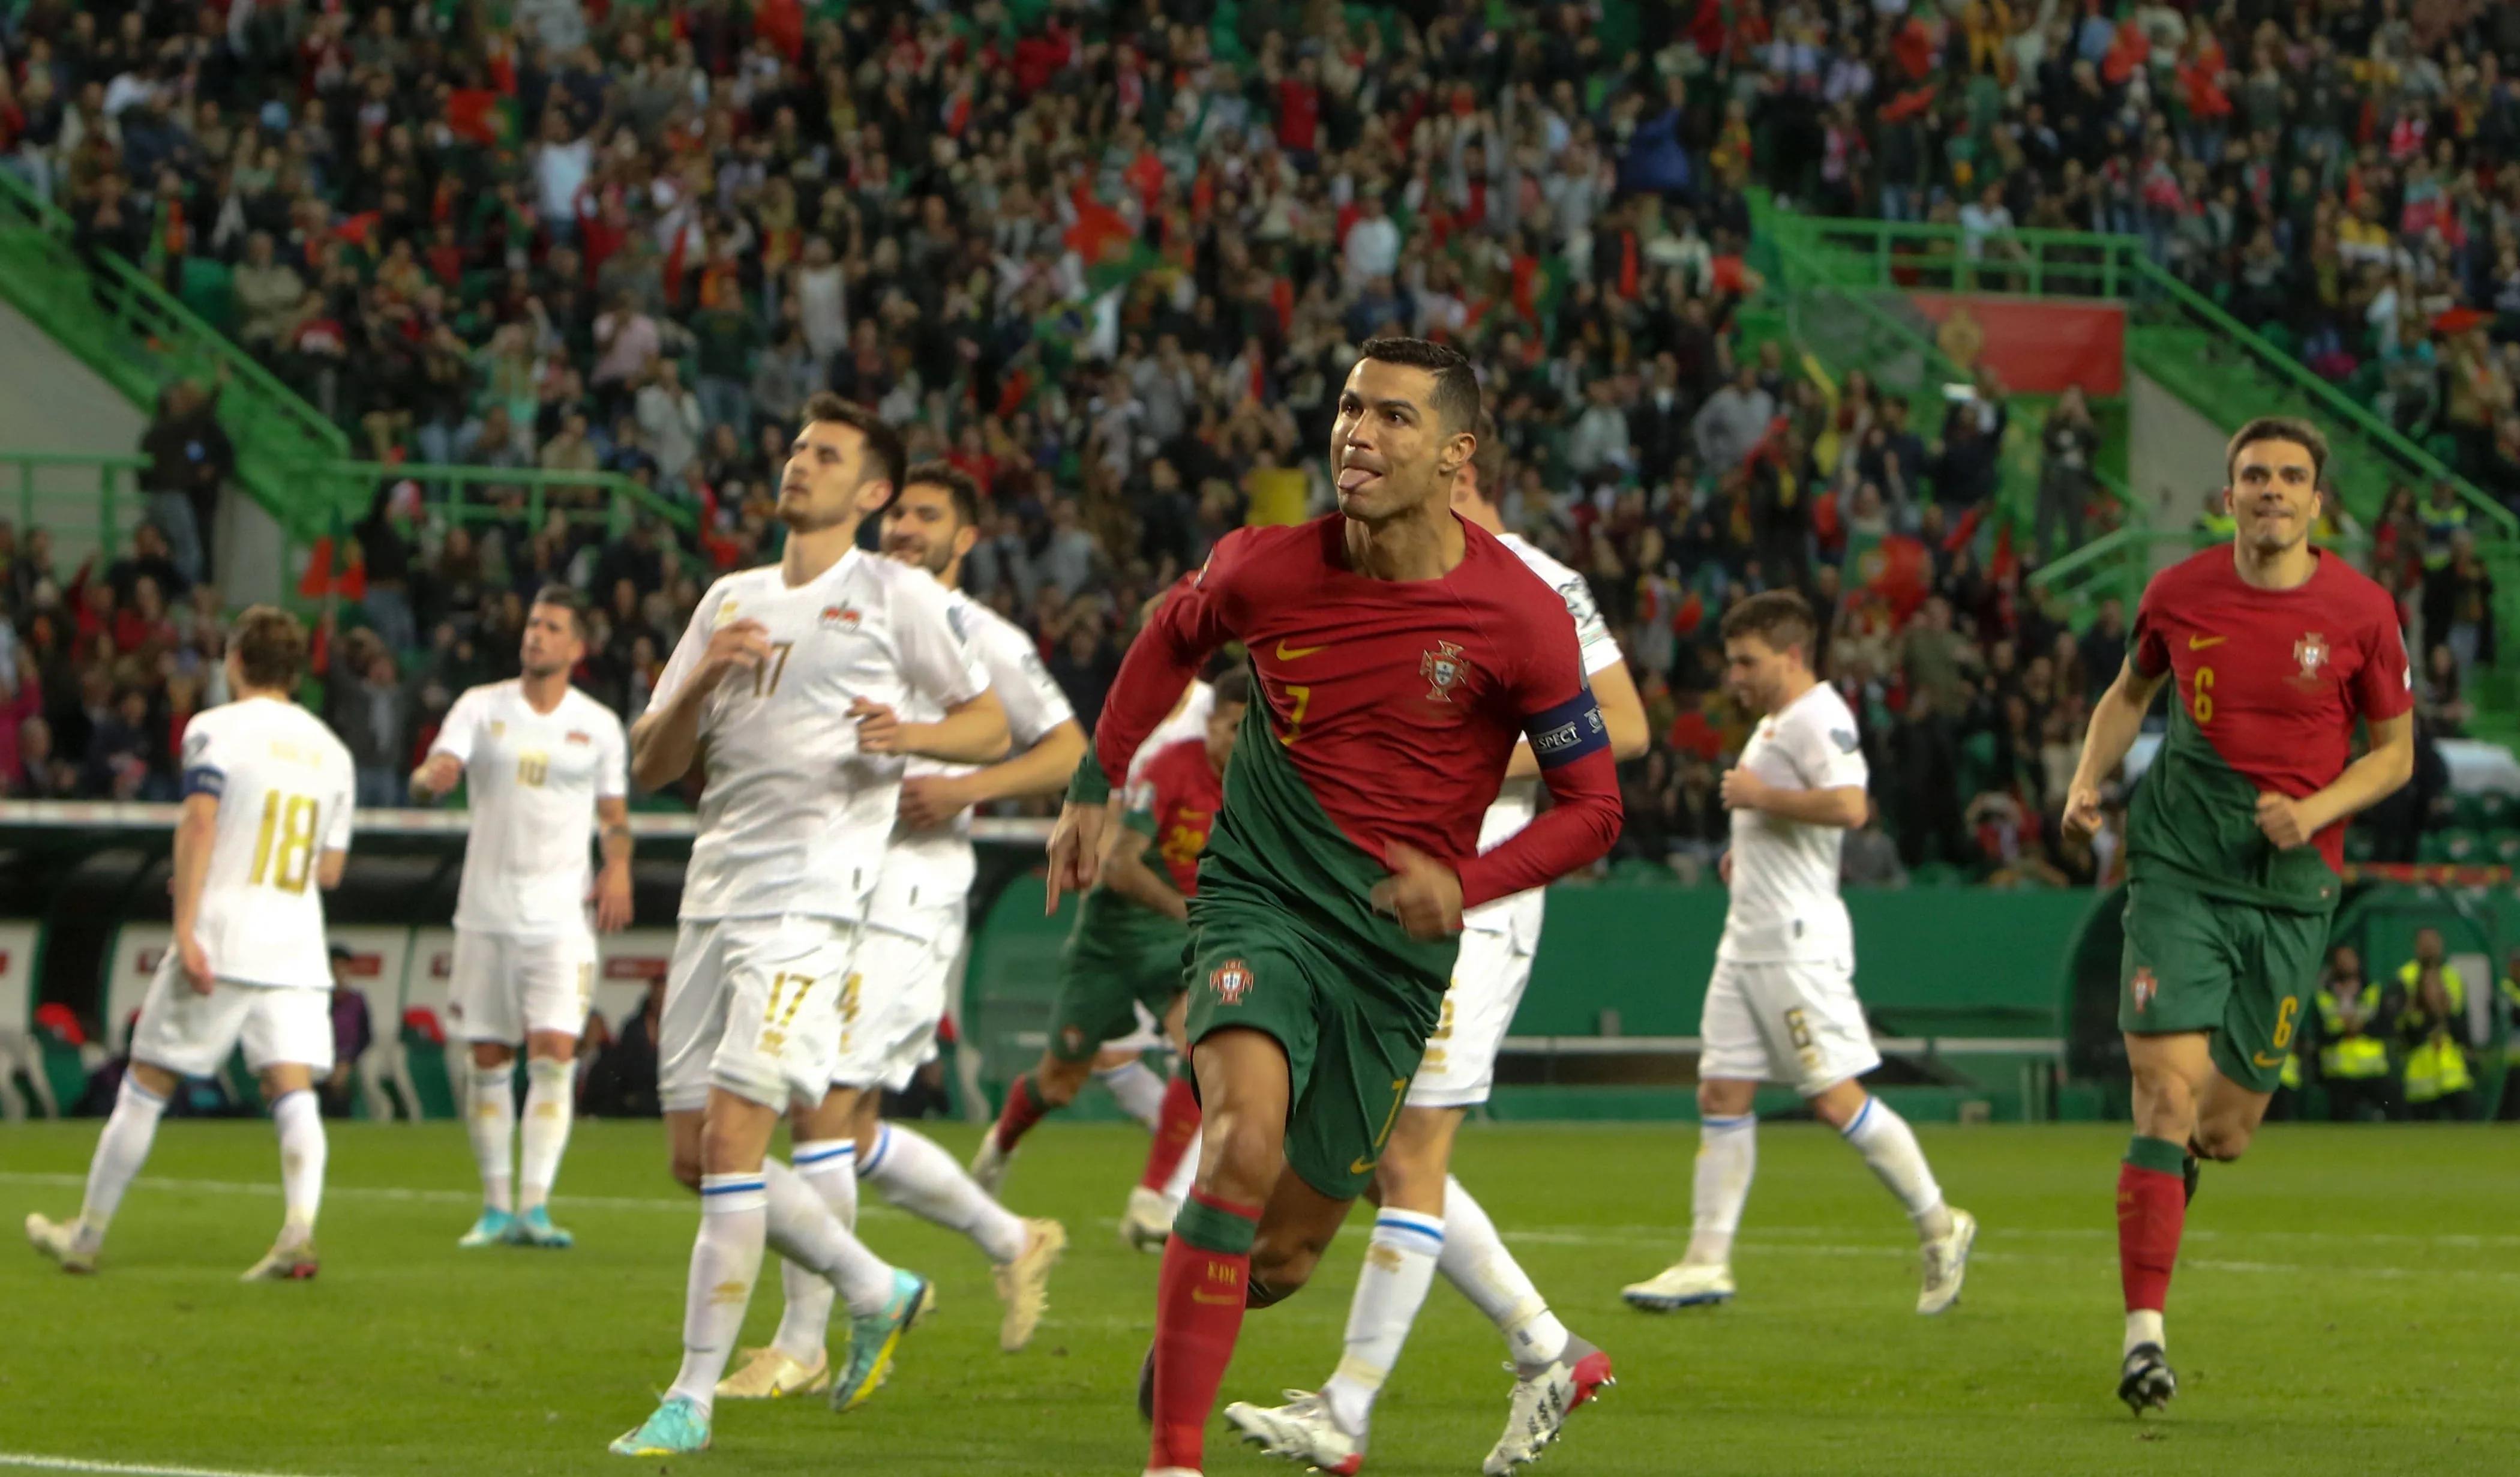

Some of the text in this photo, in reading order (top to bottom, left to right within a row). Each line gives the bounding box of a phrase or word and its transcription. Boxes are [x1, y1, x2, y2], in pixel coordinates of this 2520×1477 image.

[752, 640, 794, 698] 17
[2195, 666, 2214, 723] 6
[1280, 685, 1310, 745] 7
[1534, 725, 1577, 750] SPECT
[250, 789, 319, 896] 18
[764, 971, 815, 1027] 17
[2273, 996, 2297, 1048] 6
